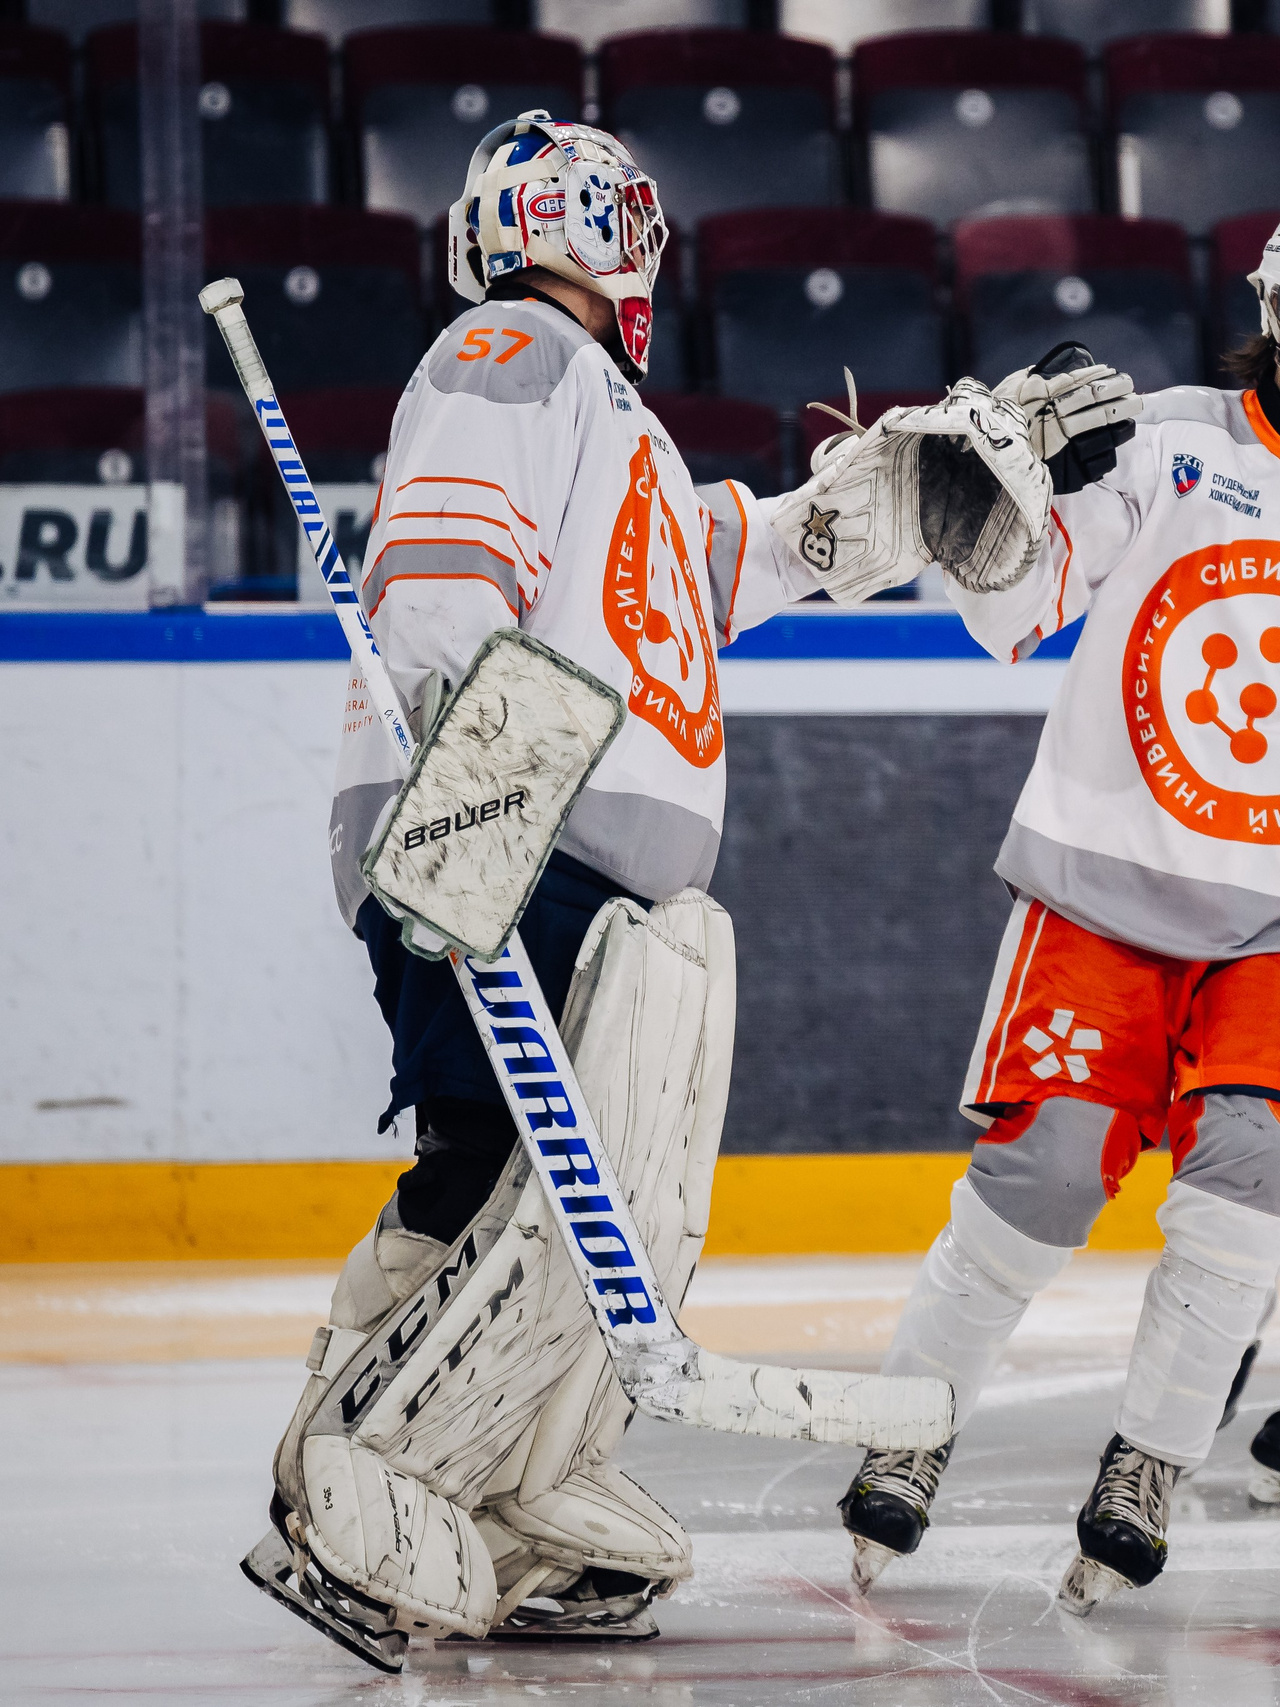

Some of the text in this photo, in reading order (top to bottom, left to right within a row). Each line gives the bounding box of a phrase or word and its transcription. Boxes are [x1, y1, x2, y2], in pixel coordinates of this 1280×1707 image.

[456, 328, 534, 365] 57
[256, 394, 324, 541] RITUAL
[0, 508, 147, 584] RU
[1135, 588, 1219, 819] УНИВЕРСИТЕТ
[404, 790, 526, 851] BAUER
[464, 947, 657, 1329] WARRIOR
[338, 1229, 481, 1424] CCM
[323, 1486, 335, 1511] 35+3
